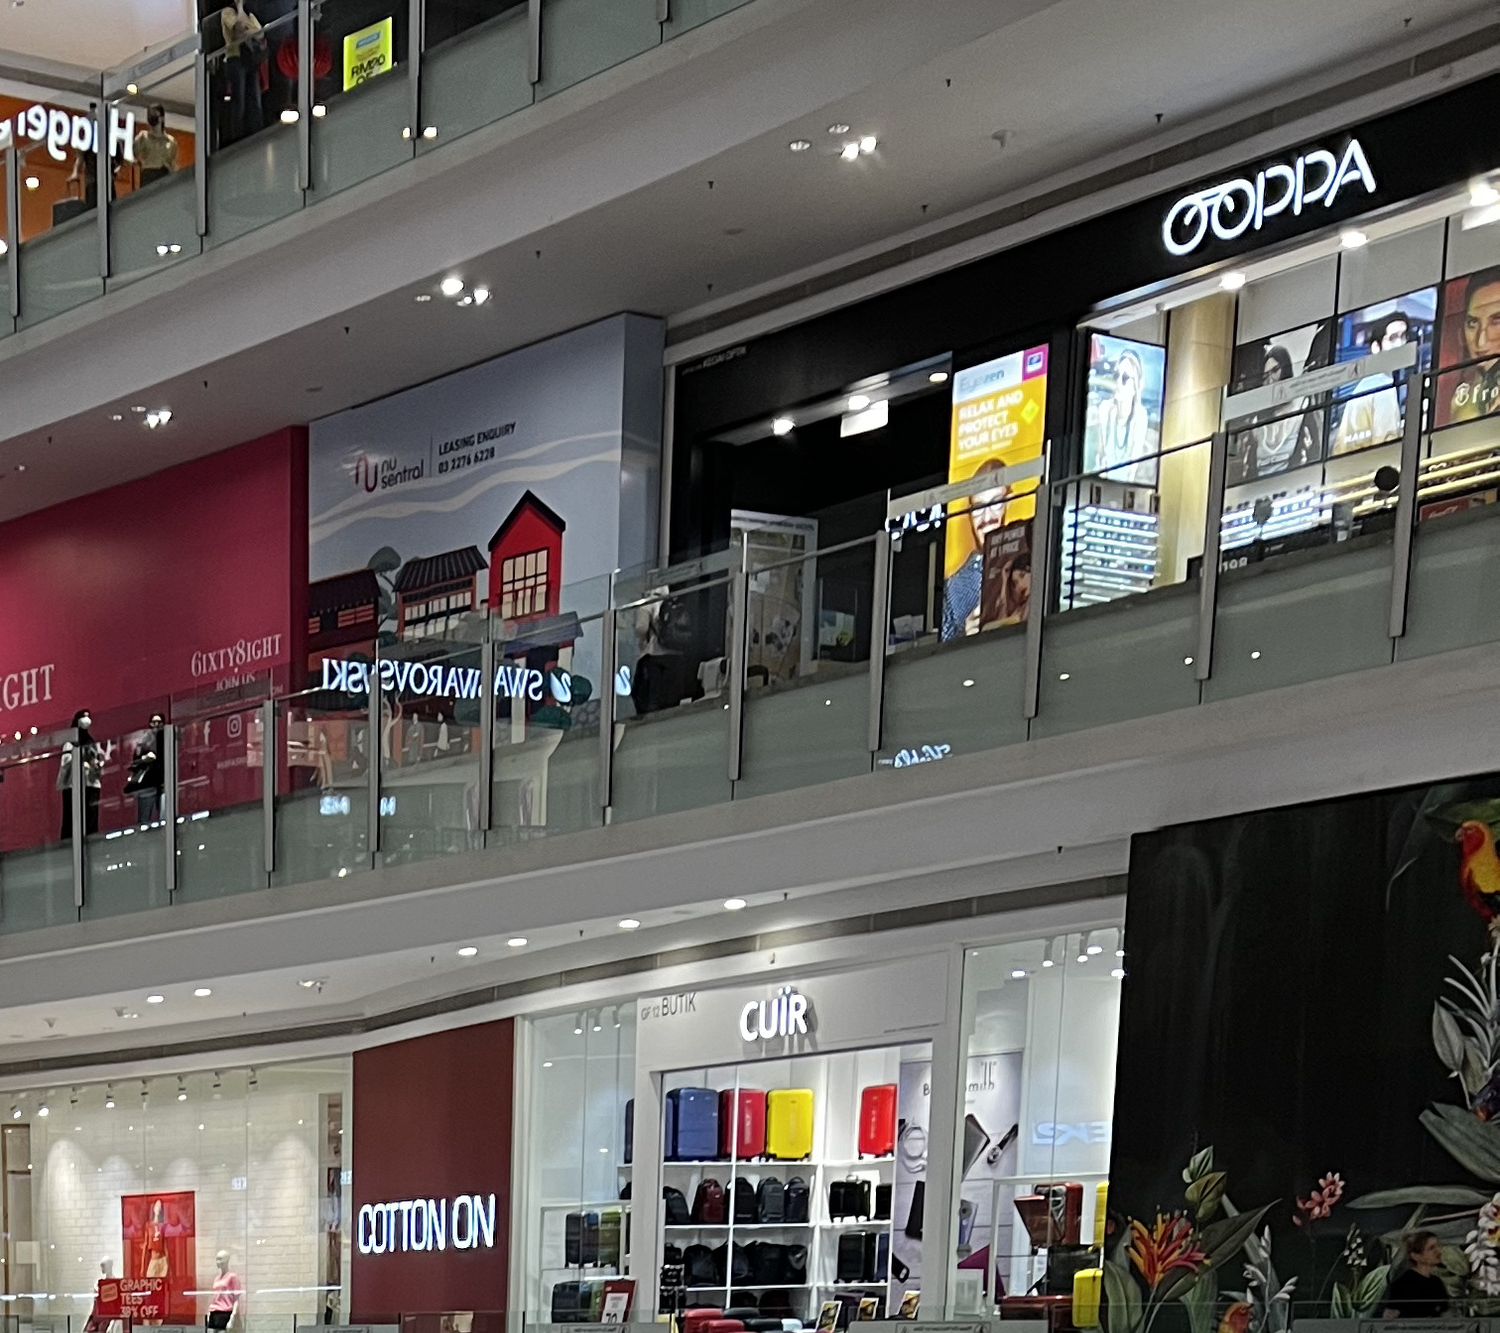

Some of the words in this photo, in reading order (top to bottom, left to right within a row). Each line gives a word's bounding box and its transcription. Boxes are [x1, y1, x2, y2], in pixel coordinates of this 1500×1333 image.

[439, 434, 476, 456] LEASING
[477, 421, 517, 445] ENQUIRY
[661, 991, 697, 1017] BUTIK
[356, 1196, 447, 1255] COTTON
[450, 1193, 497, 1249] ON
[120, 1279, 163, 1292] GRAPHIC
